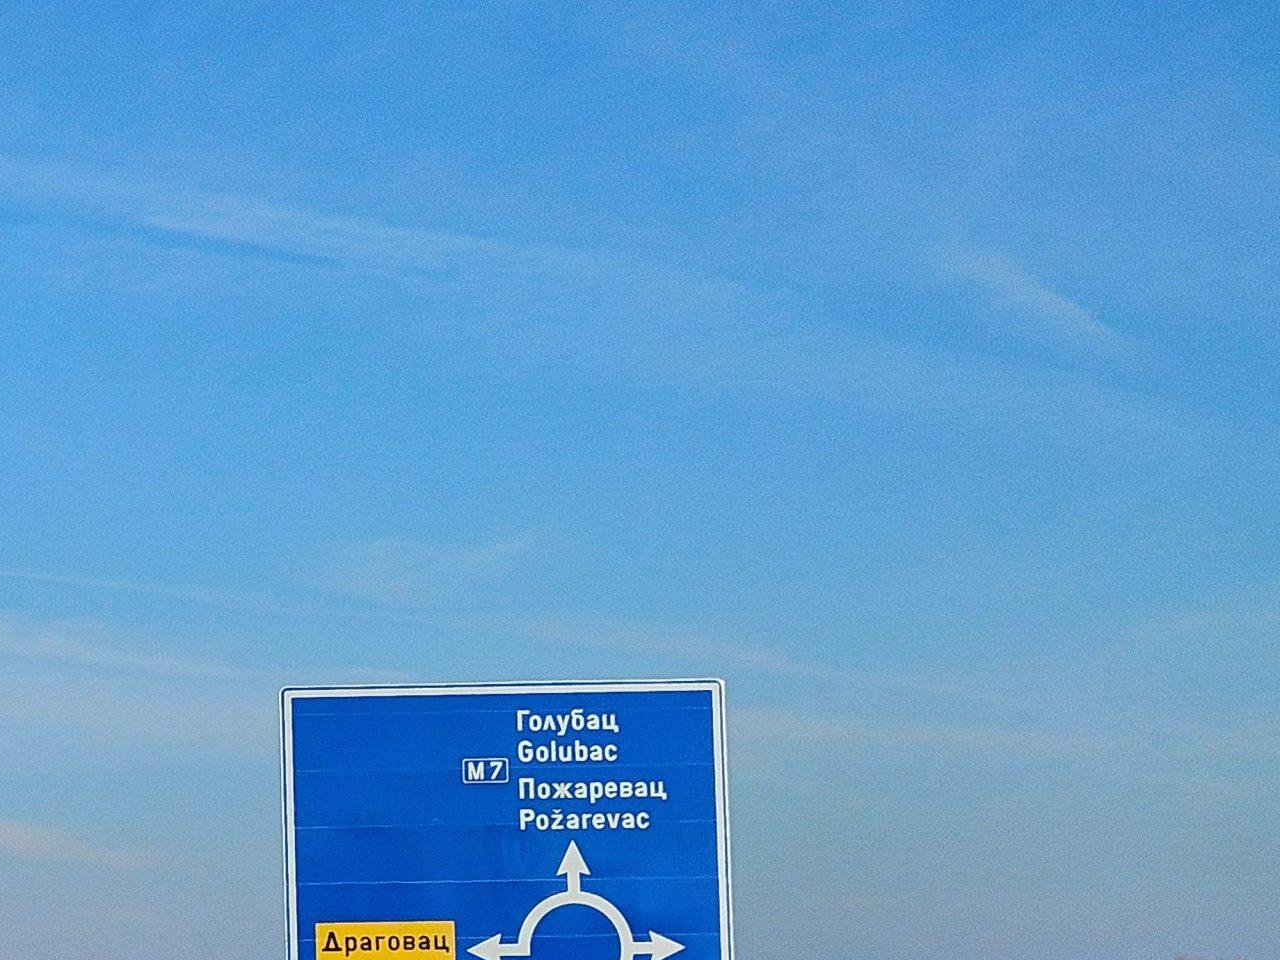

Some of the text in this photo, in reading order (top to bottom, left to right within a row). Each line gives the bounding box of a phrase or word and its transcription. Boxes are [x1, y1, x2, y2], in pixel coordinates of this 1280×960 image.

[517, 709, 619, 736] Голубац
[517, 740, 618, 763] Golubac
[519, 778, 667, 803] Пожаревац
[519, 808, 650, 831] Požarevac
[322, 931, 450, 958] Драговац
